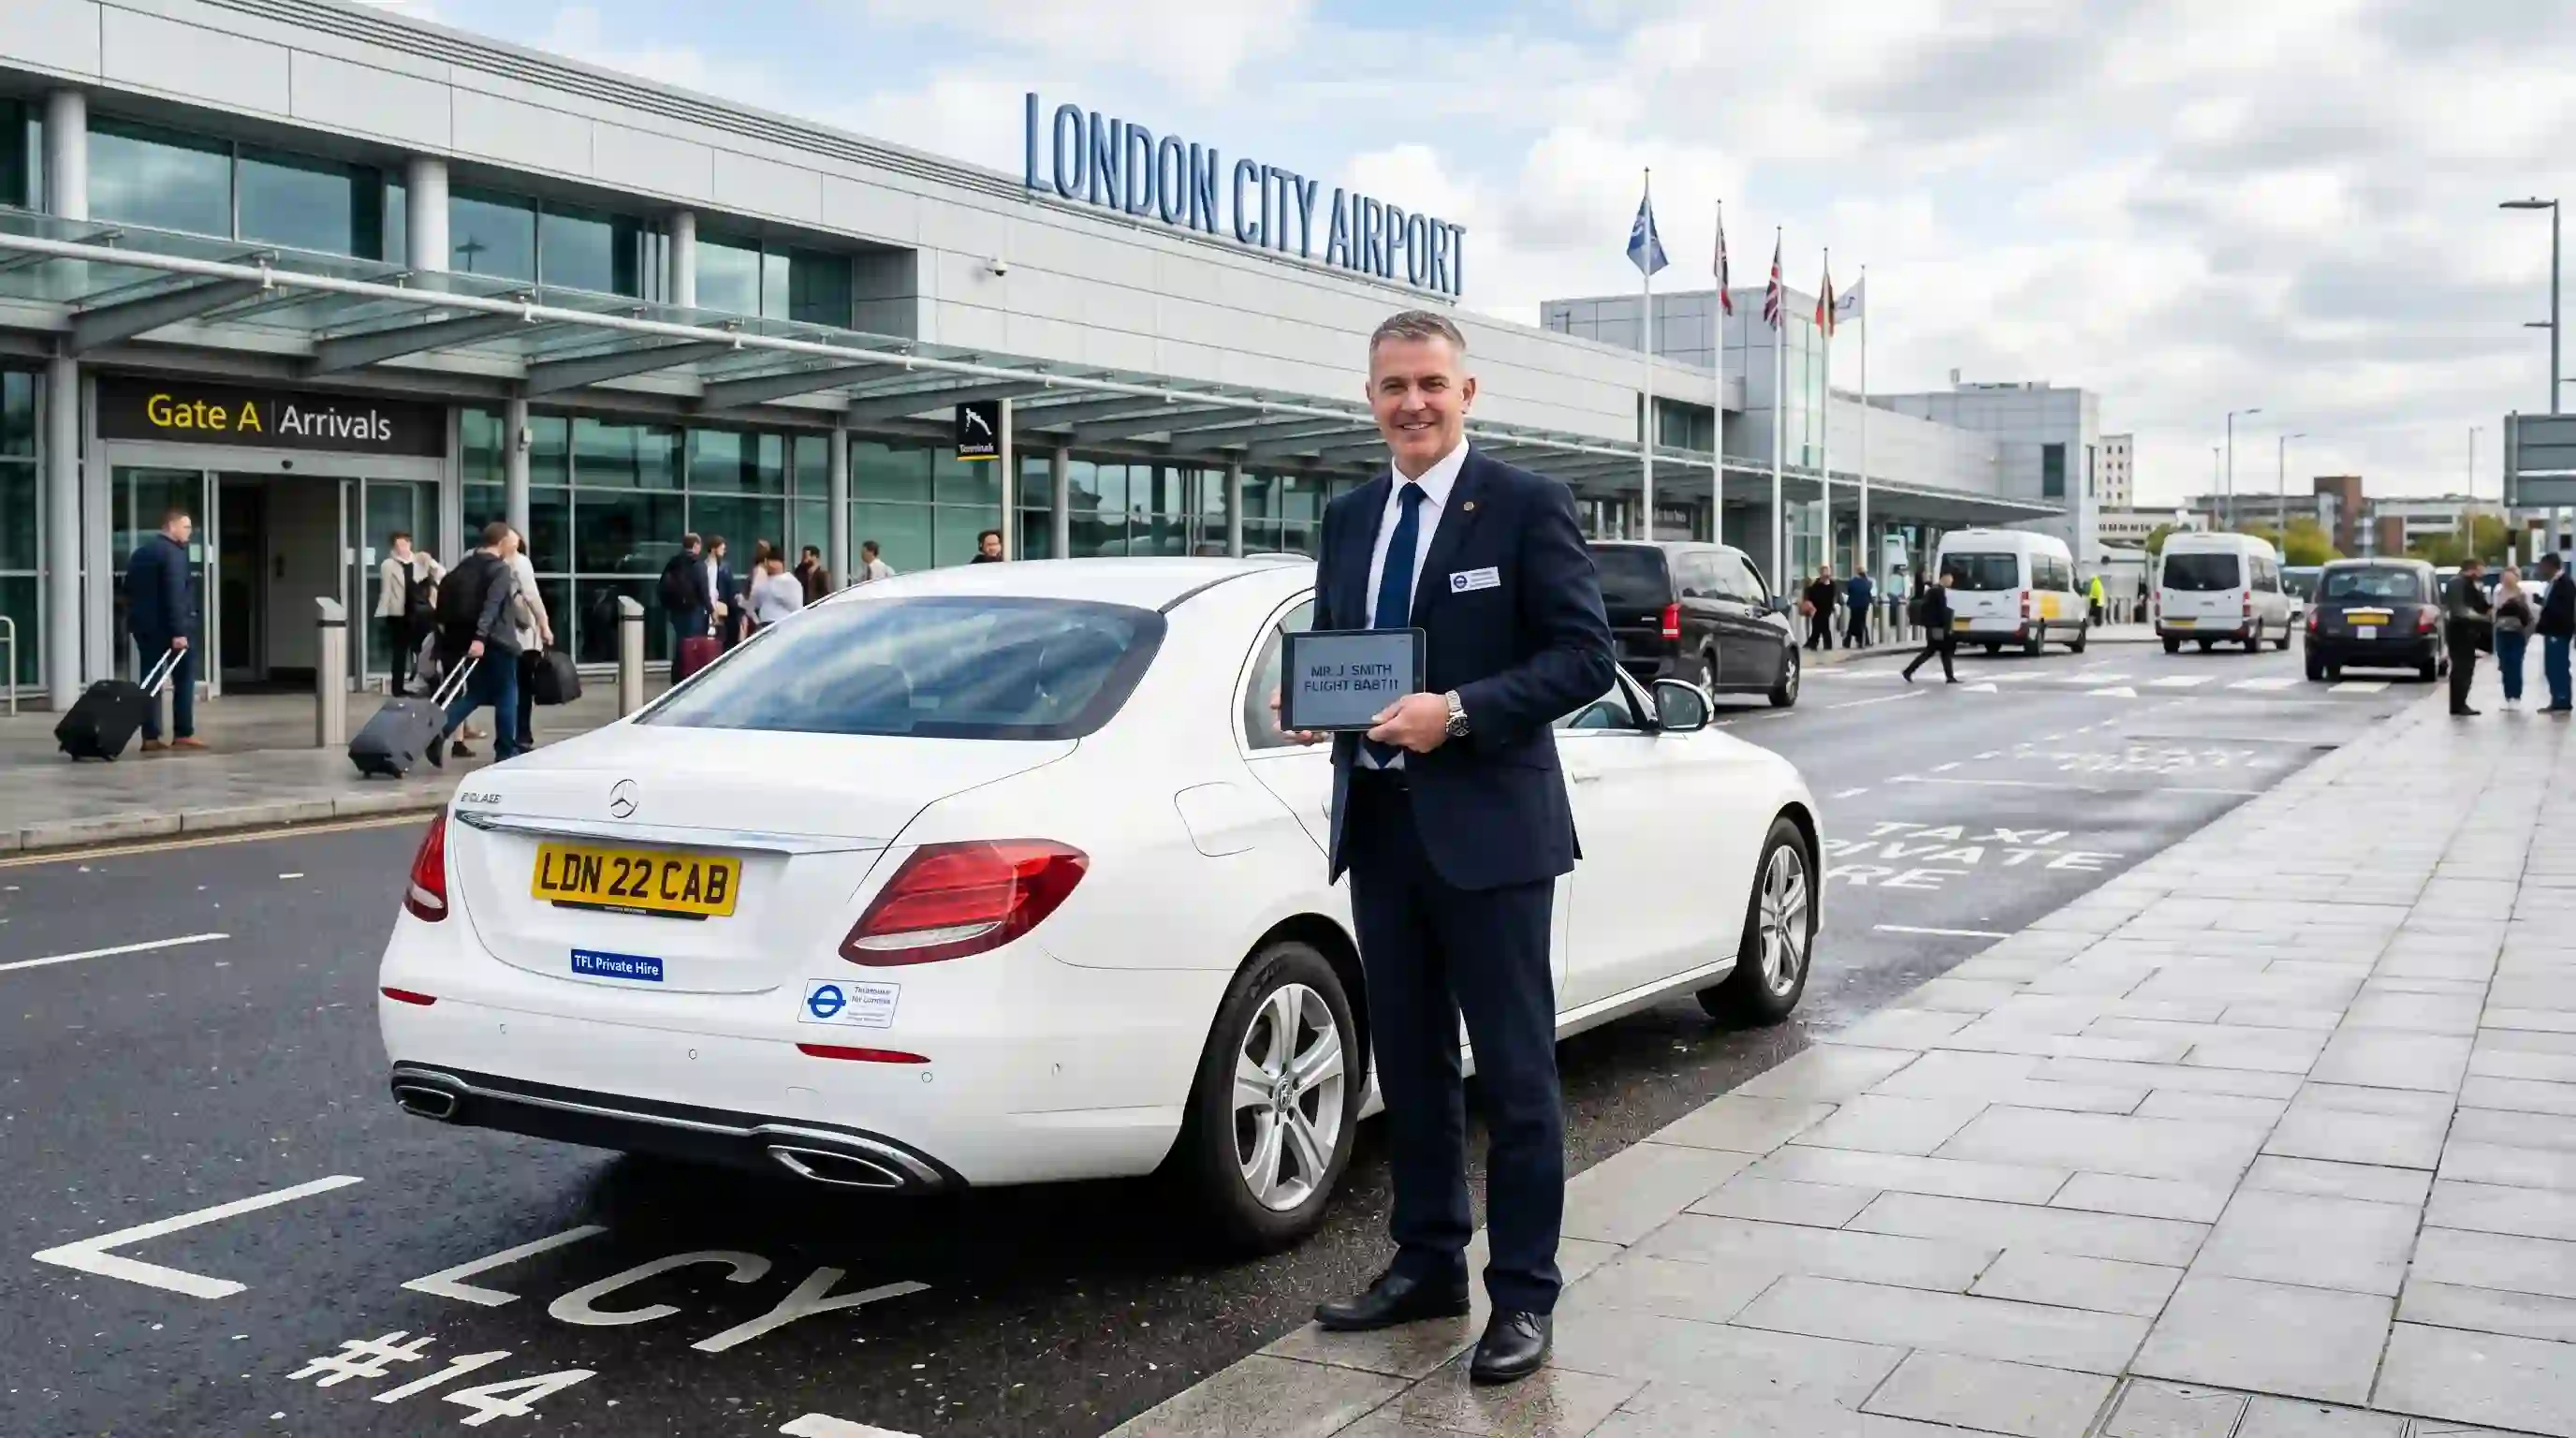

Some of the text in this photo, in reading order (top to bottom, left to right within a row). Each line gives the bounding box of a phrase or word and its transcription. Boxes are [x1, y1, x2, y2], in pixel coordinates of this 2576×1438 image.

[1026, 92, 1468, 297] LONDON CITY AIRPORT
[147, 393, 392, 441] Gate A Arrivals
[1304, 680, 1349, 692] FLIGHT
[1352, 664, 1392, 676] SMITH
[1867, 821, 2071, 844] TAXI
[1823, 838, 2126, 871] IVATE
[541, 852, 729, 904] LDN 22 CAB
[1824, 863, 1971, 890] RE
[574, 954, 660, 976] TFL Private Hire
[400, 1225, 933, 1353] LCY
[285, 1330, 598, 1427] #14
